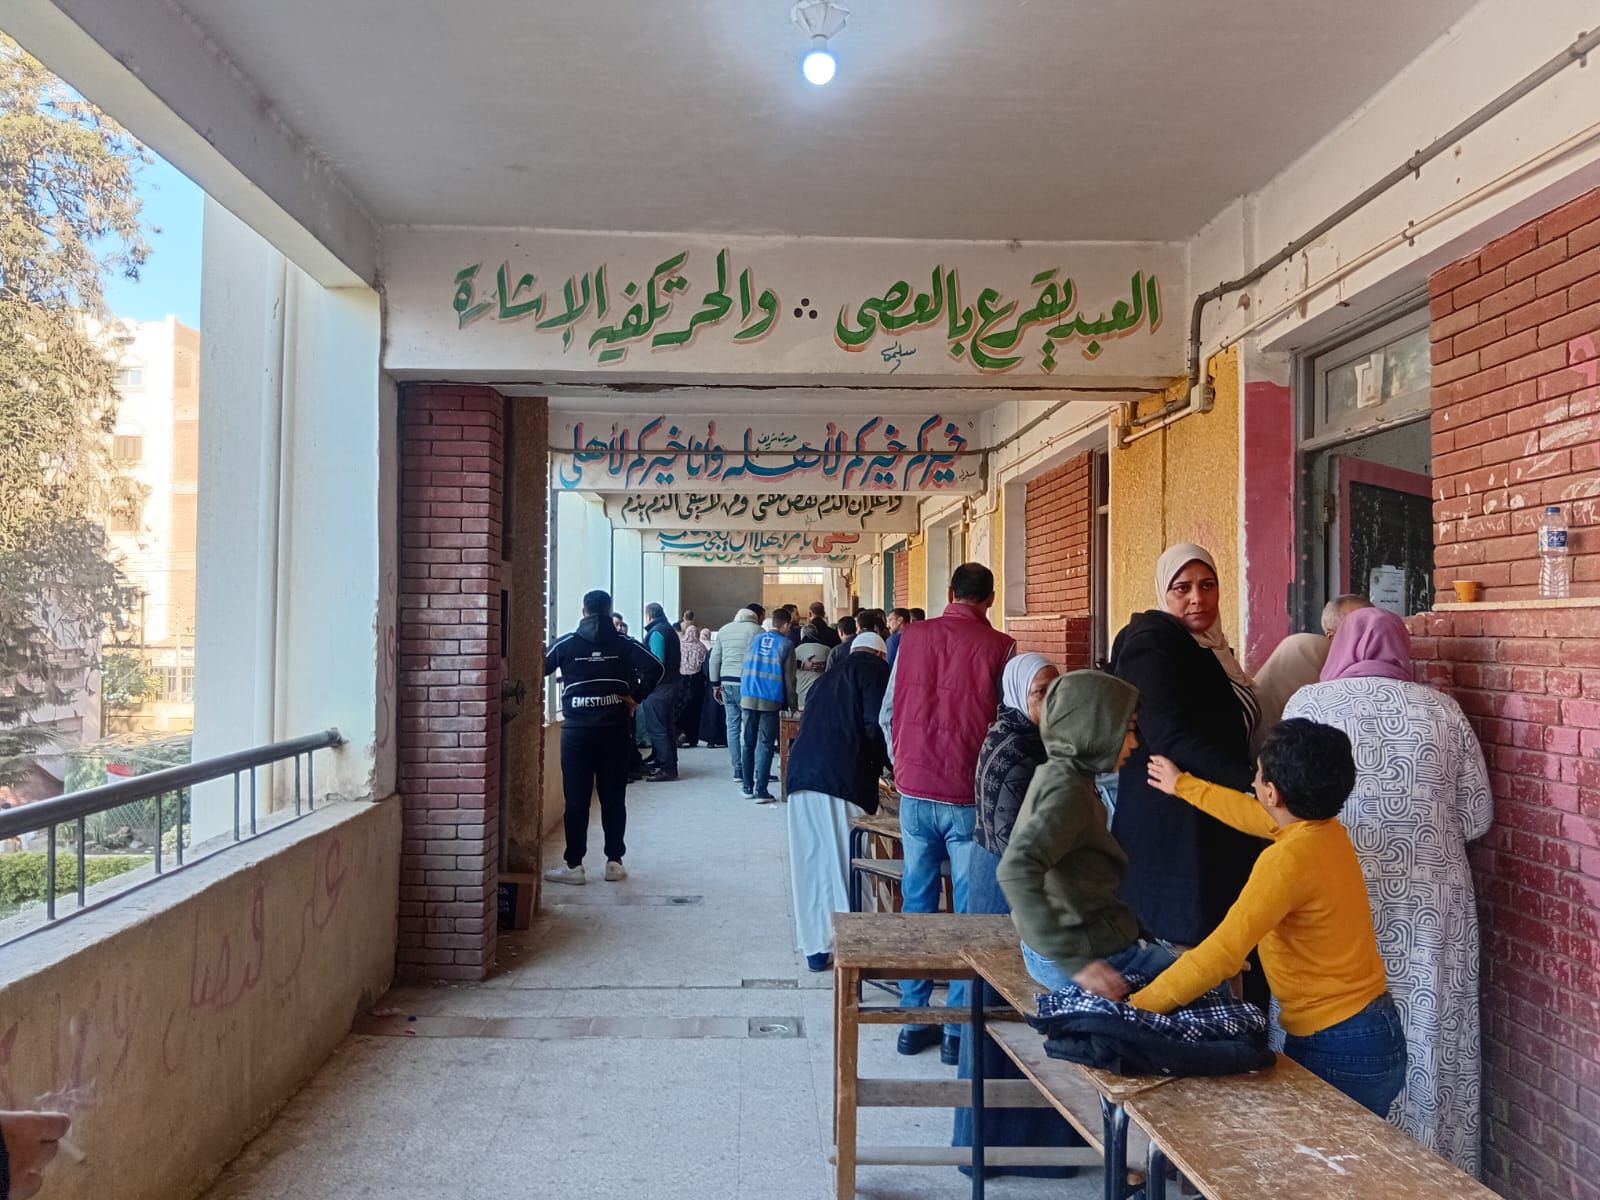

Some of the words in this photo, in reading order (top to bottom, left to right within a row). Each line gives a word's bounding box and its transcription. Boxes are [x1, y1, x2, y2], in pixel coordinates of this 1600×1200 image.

[587, 250, 690, 364] تكفيه
[652, 248, 780, 347] والحر
[968, 268, 1077, 372] يقرع
[1046, 270, 1159, 358] العبد
[625, 415, 688, 490] خيركم
[758, 433, 778, 450] شريف
[842, 415, 907, 490] خيركم
[903, 414, 968, 491] خيركم
